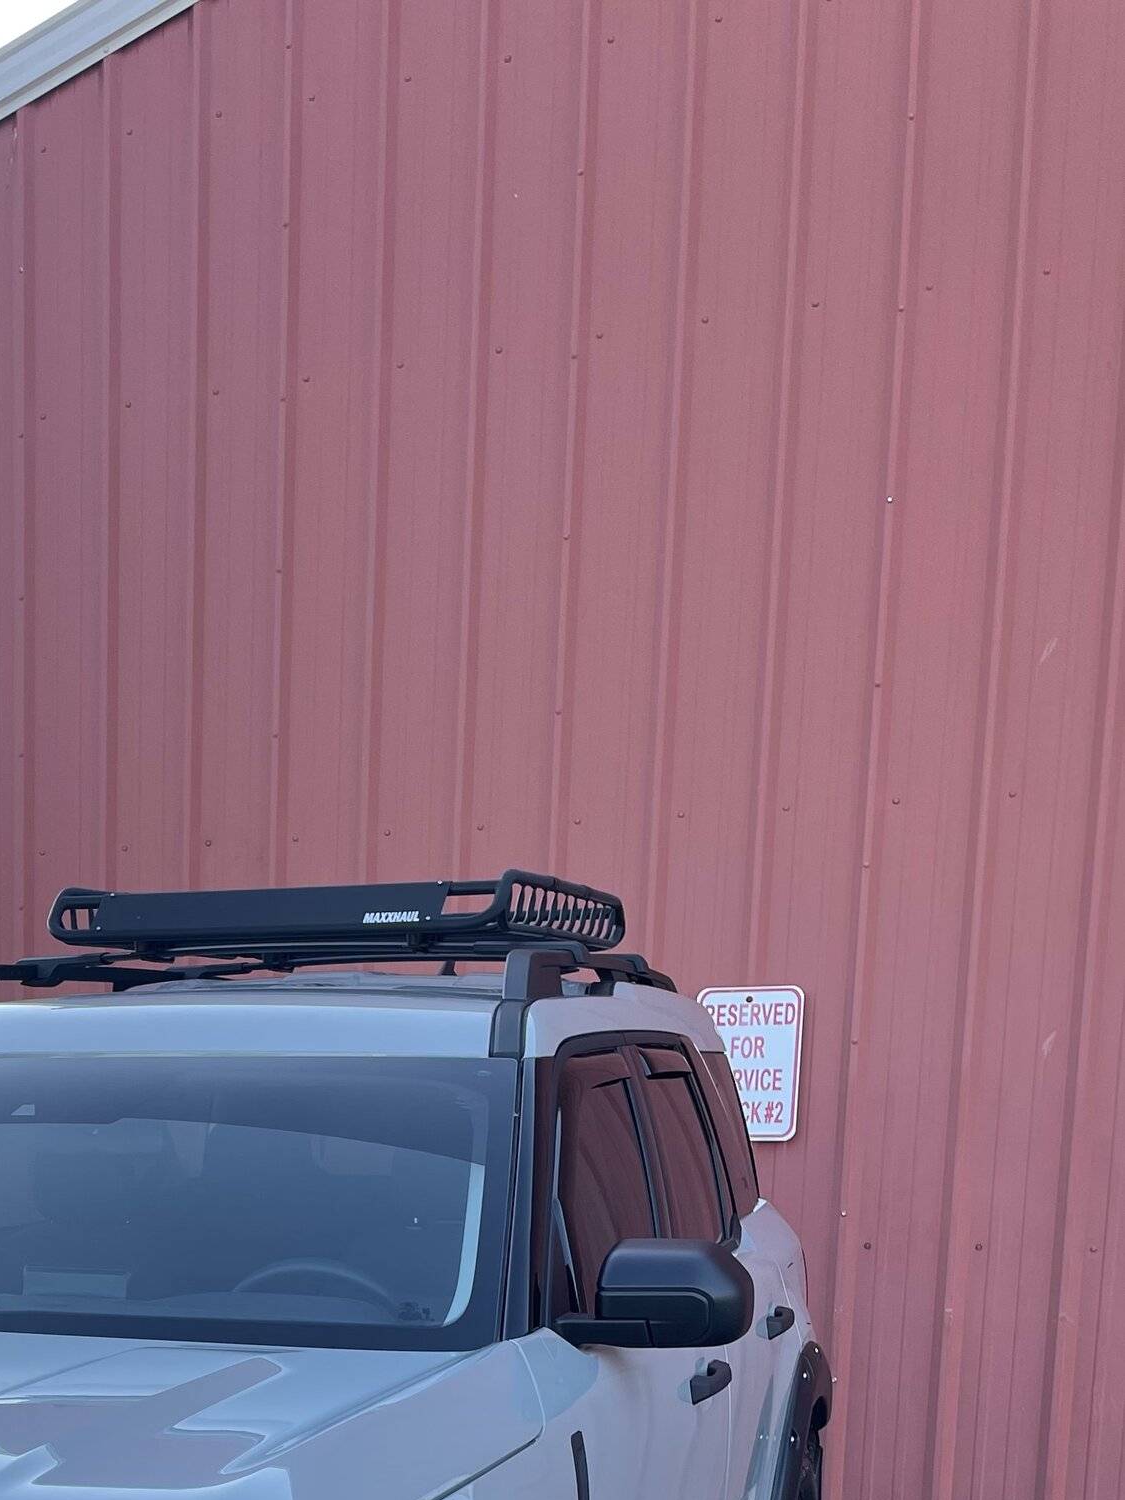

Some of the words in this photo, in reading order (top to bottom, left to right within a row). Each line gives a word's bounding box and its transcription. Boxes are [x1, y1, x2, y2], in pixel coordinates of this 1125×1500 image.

[362, 910, 420, 924] MAXXHAUL
[730, 1036, 765, 1059] FOR
[733, 1068, 783, 1091] RVICE
[764, 1101, 783, 1124] #2
